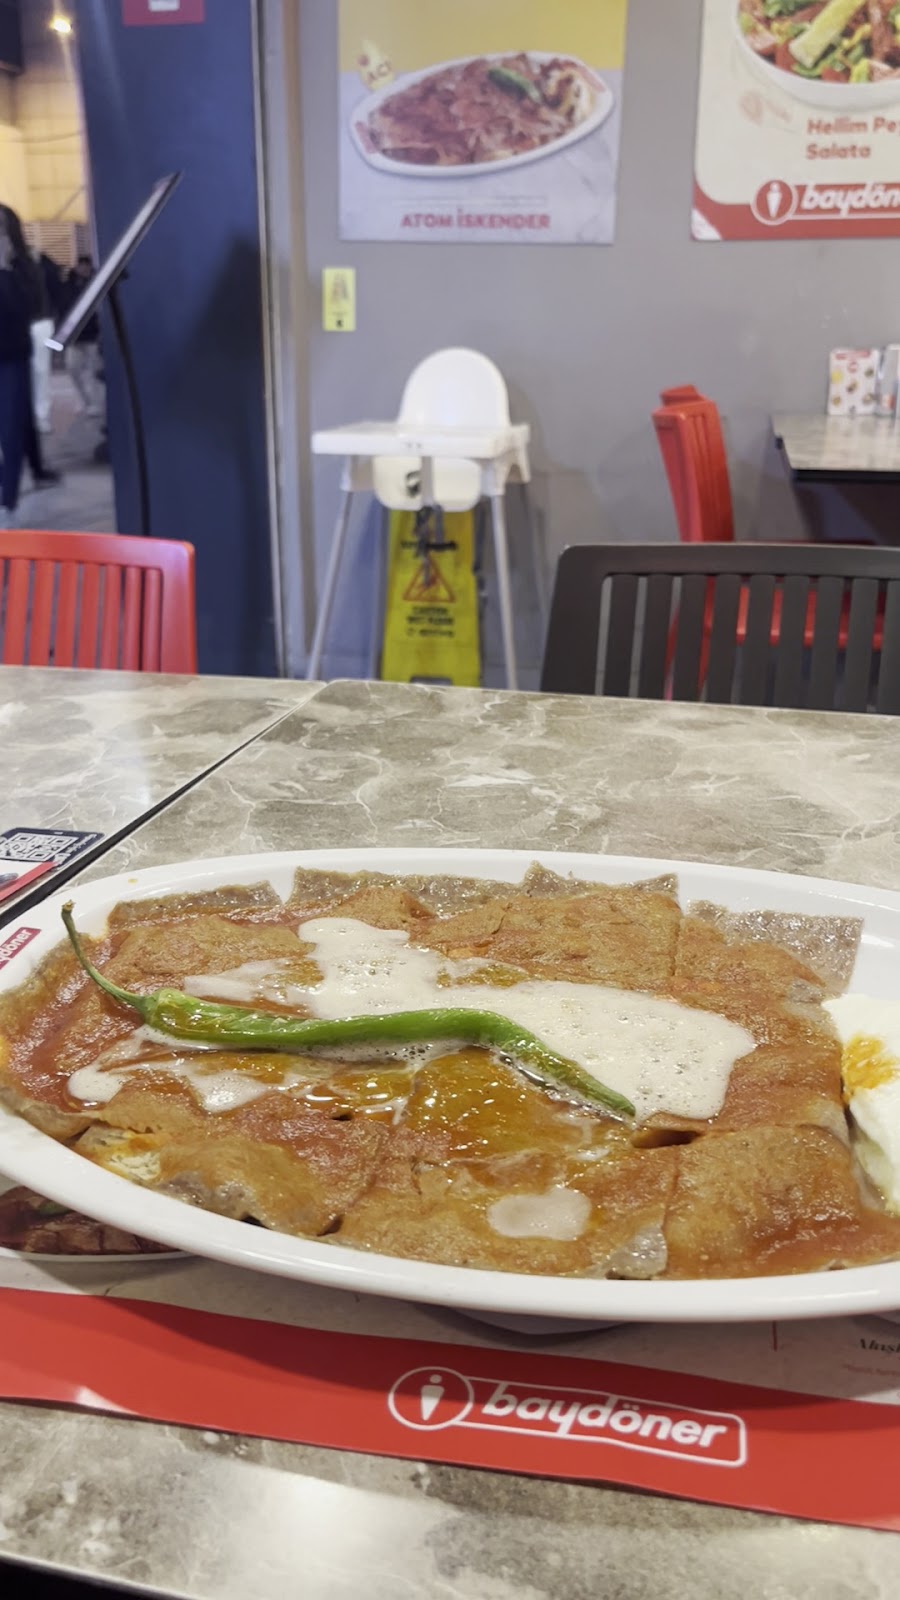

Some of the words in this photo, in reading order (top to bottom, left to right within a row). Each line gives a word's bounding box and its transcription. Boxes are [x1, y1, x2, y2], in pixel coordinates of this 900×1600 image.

[807, 117, 868, 134] Hellim
[873, 116, 900, 136] Pe
[806, 143, 871, 159] Salata
[401, 213, 454, 229] ATOM
[456, 207, 551, 230] İSKENDER
[482, 1381, 727, 1448] baydöner
